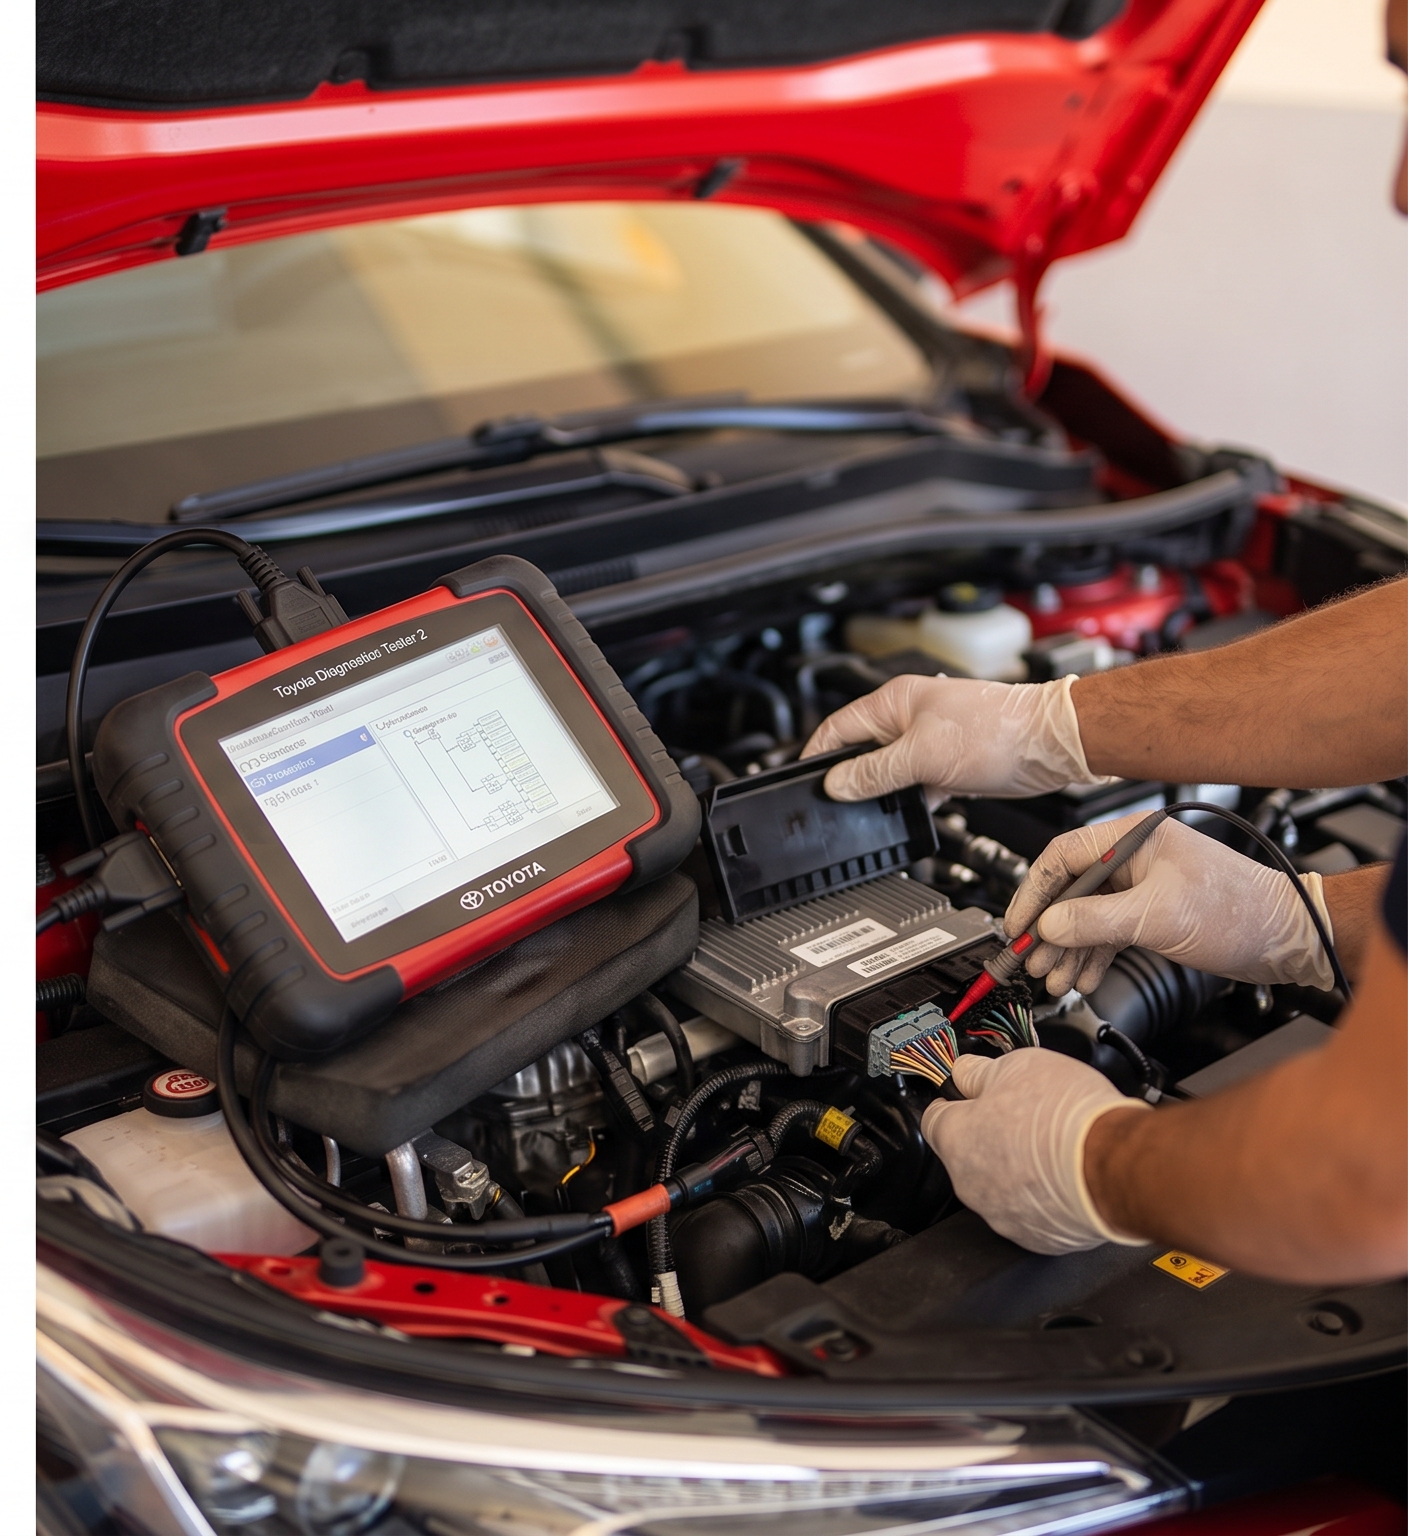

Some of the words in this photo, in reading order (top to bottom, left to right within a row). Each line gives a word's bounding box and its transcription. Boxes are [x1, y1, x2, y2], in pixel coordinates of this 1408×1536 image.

[273, 677, 317, 698] Toyota
[416, 628, 428, 641] 2
[482, 861, 546, 899] TOYOTA
